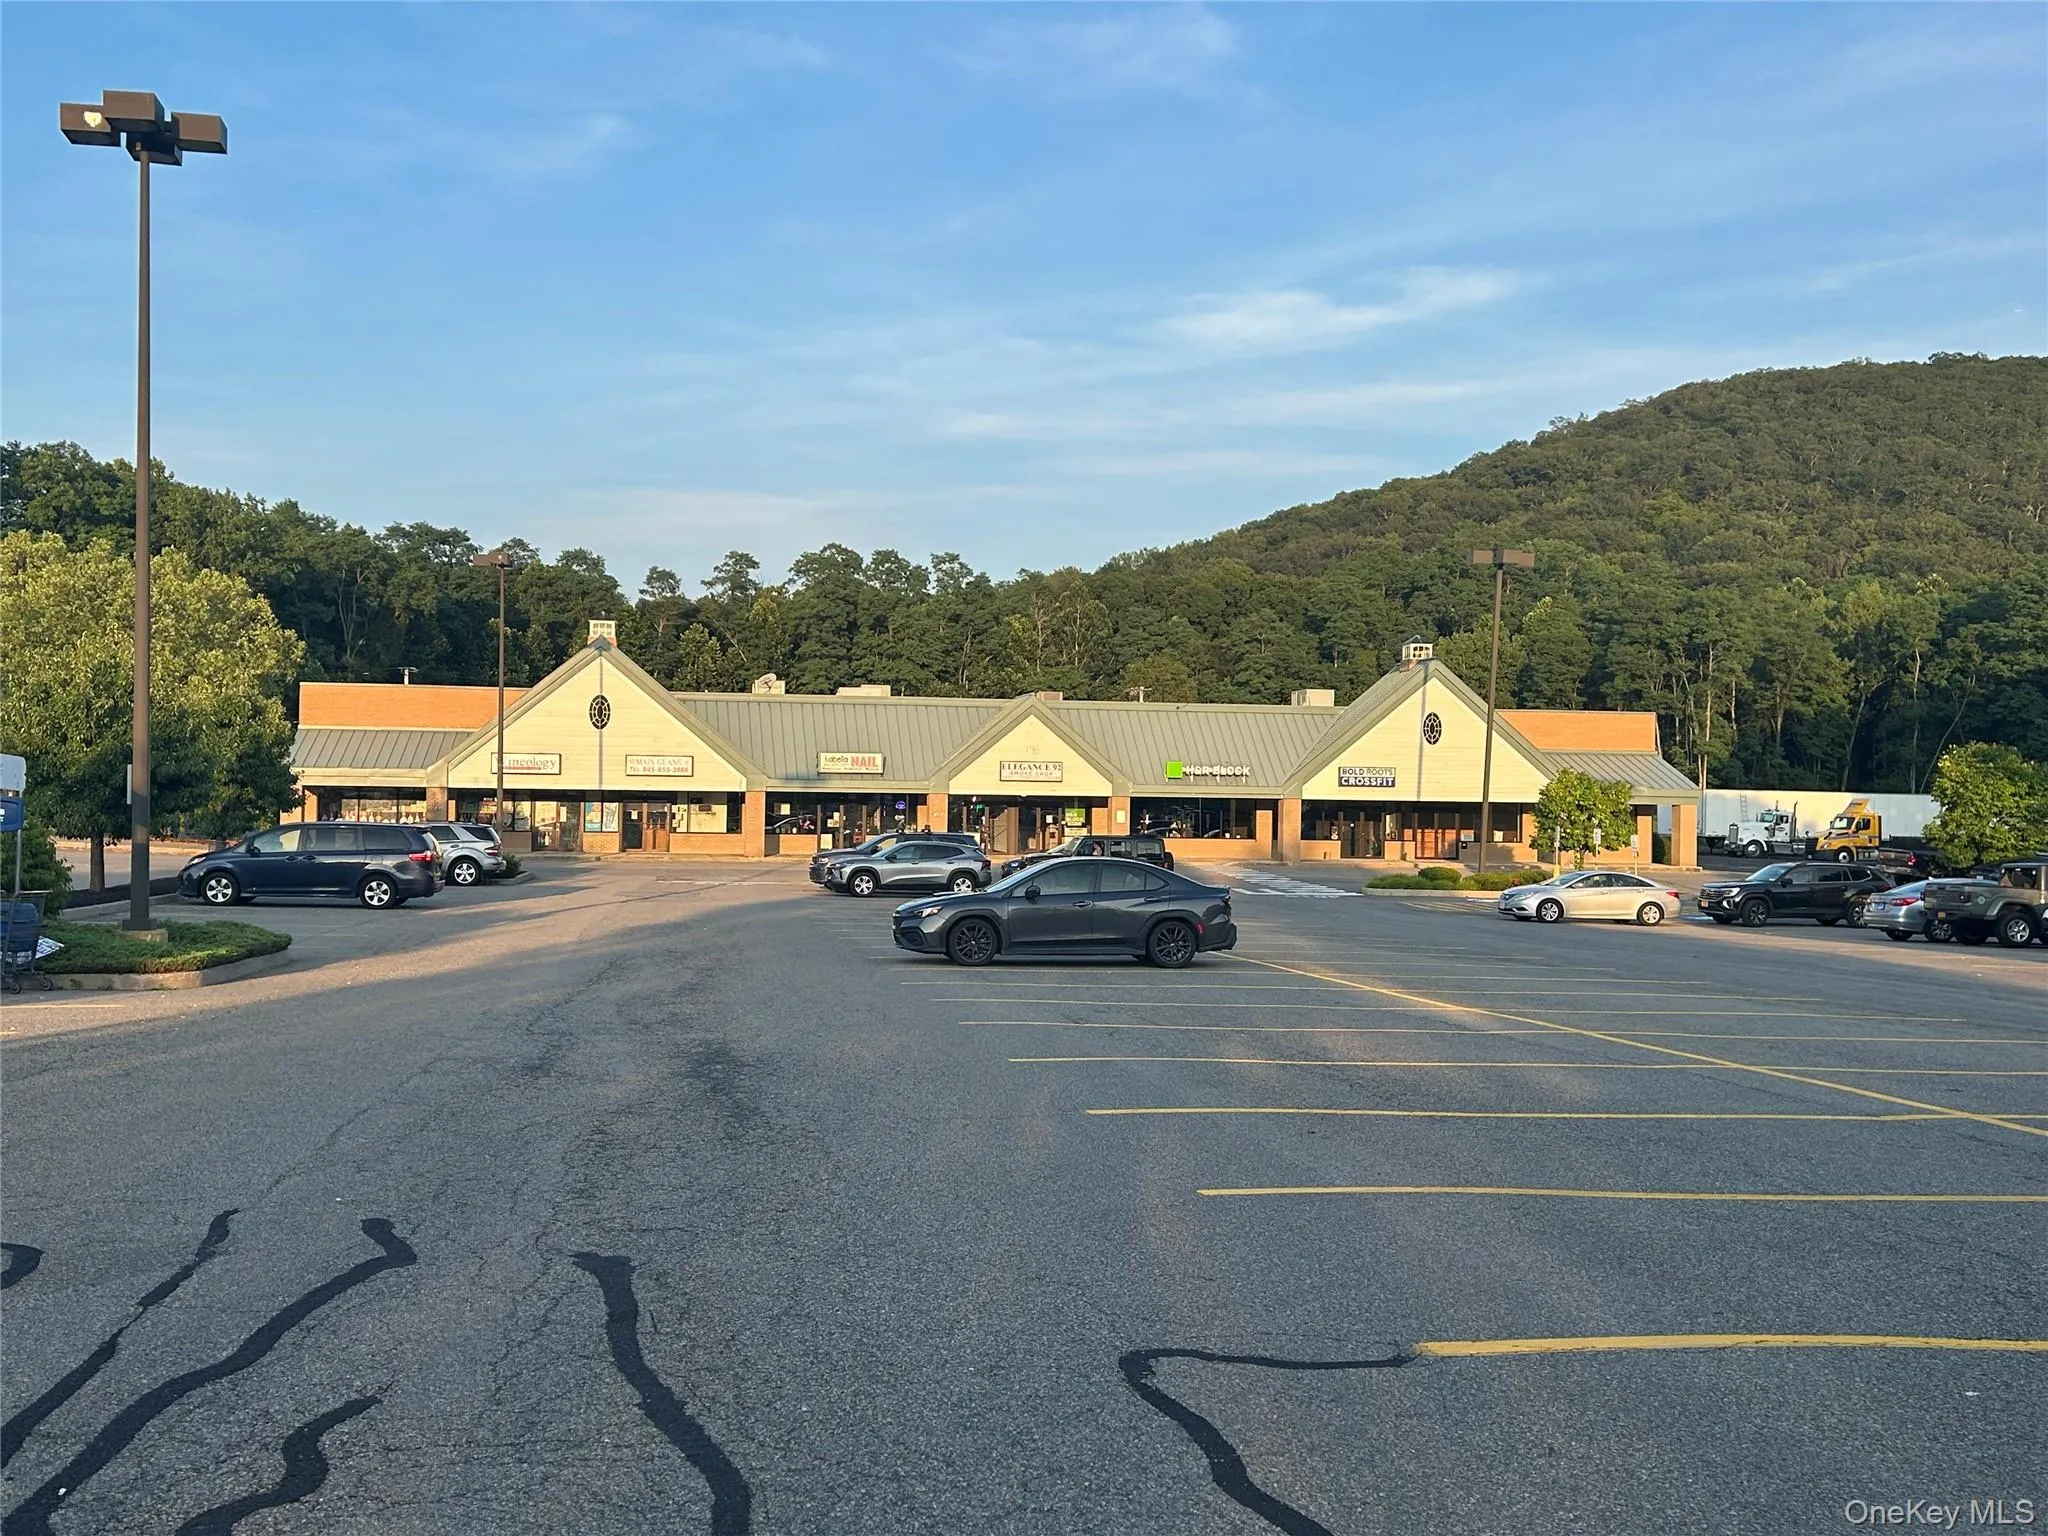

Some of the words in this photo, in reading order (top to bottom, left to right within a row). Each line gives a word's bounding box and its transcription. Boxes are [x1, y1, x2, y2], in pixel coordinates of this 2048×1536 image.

[1213, 765, 1251, 777] BLOCK
[1342, 768, 1365, 776] BOLD
[1366, 768, 1393, 776] ROOTS
[1341, 777, 1394, 786] CROSSFIT
